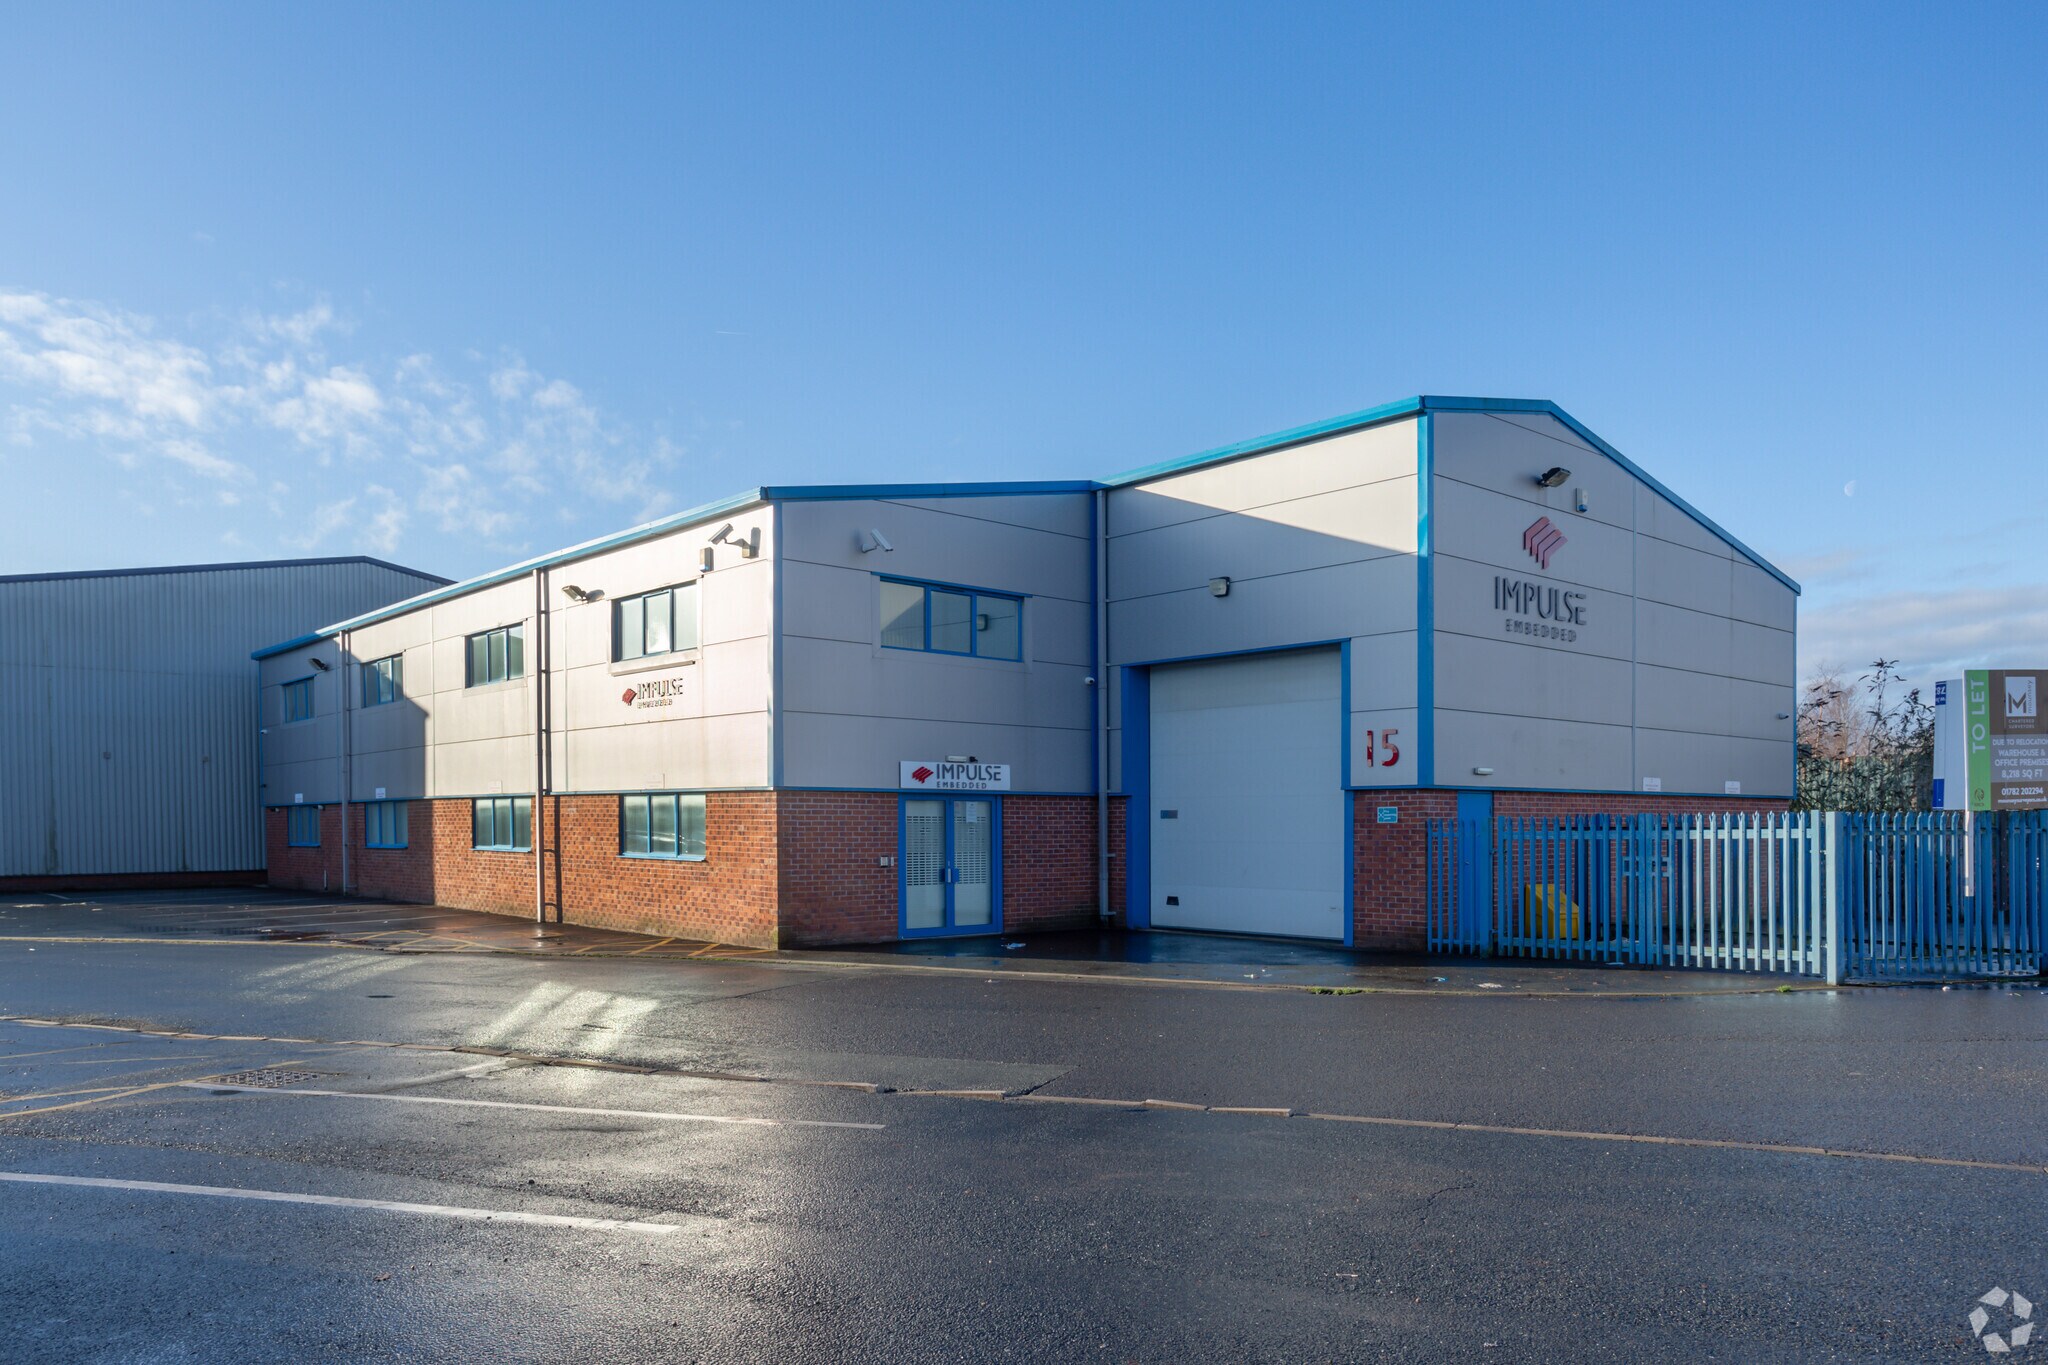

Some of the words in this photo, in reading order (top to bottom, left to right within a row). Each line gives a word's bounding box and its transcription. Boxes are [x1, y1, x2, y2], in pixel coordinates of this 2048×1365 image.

[1495, 576, 1587, 625] IMPULSE
[1505, 618, 1577, 642] EMBEDDED
[637, 678, 683, 699] IMPULSE
[1970, 679, 1985, 715] LET
[1367, 728, 1399, 767] 15
[1972, 723, 1986, 754] TO
[1992, 738, 2005, 746] DUE
[2006, 738, 2015, 746] TO
[1998, 748, 2039, 757] WAREHOUSE
[936, 763, 1001, 781] IMPULSE
[1994, 759, 2018, 767] OFFICE
[2022, 769, 2033, 779] SQ
[2034, 769, 2043, 777] FT
[936, 781, 987, 789] EMBEDDED
[2001, 787, 2019, 796] 01782
